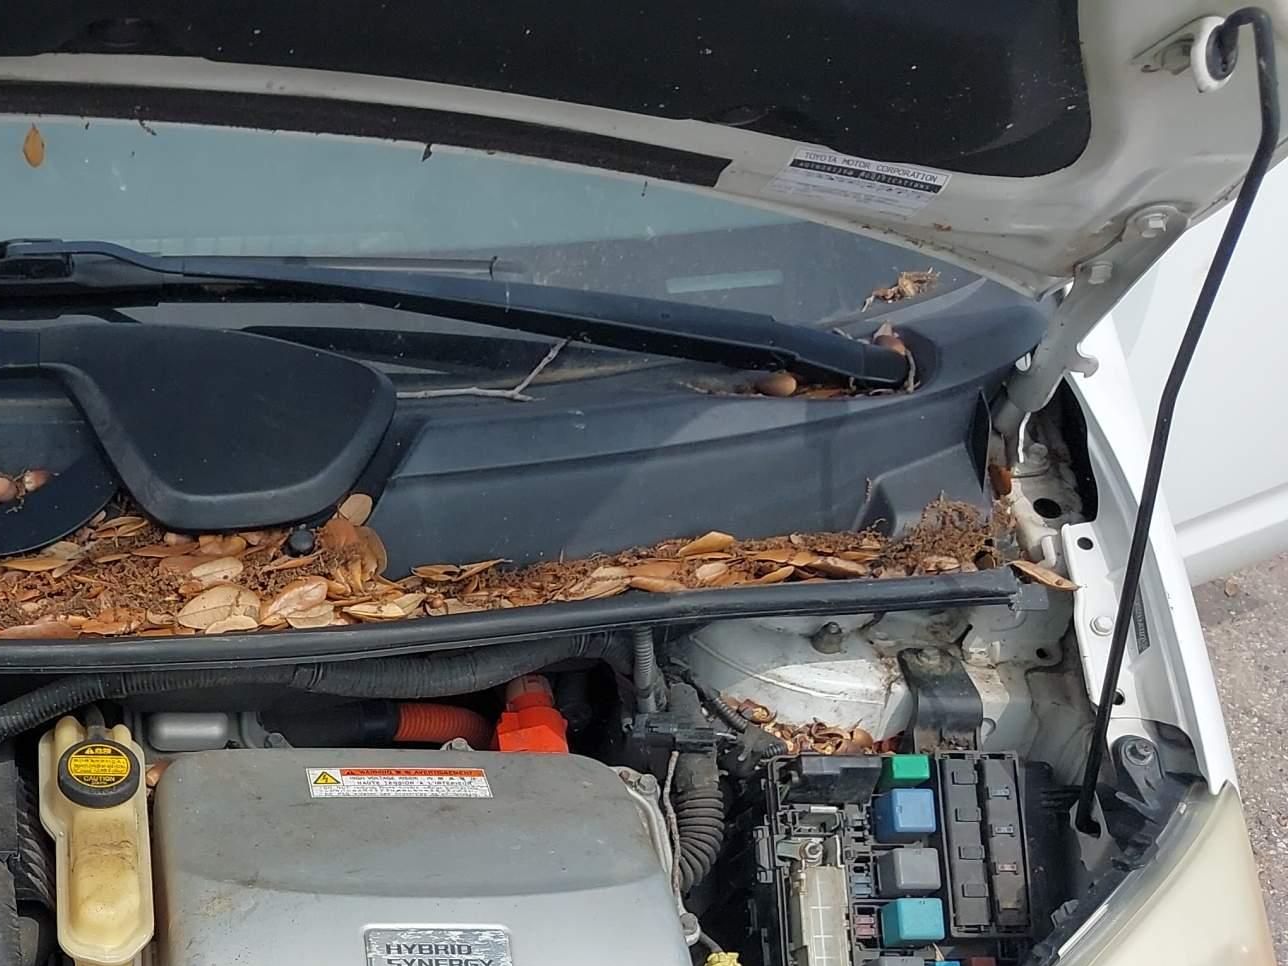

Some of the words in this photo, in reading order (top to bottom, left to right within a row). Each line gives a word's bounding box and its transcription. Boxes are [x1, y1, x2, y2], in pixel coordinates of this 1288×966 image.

[804, 151, 837, 163] TOYOTA
[841, 159, 871, 169] MOTOR
[876, 164, 938, 182] CORPORATION
[385, 943, 472, 955] HYBRID
